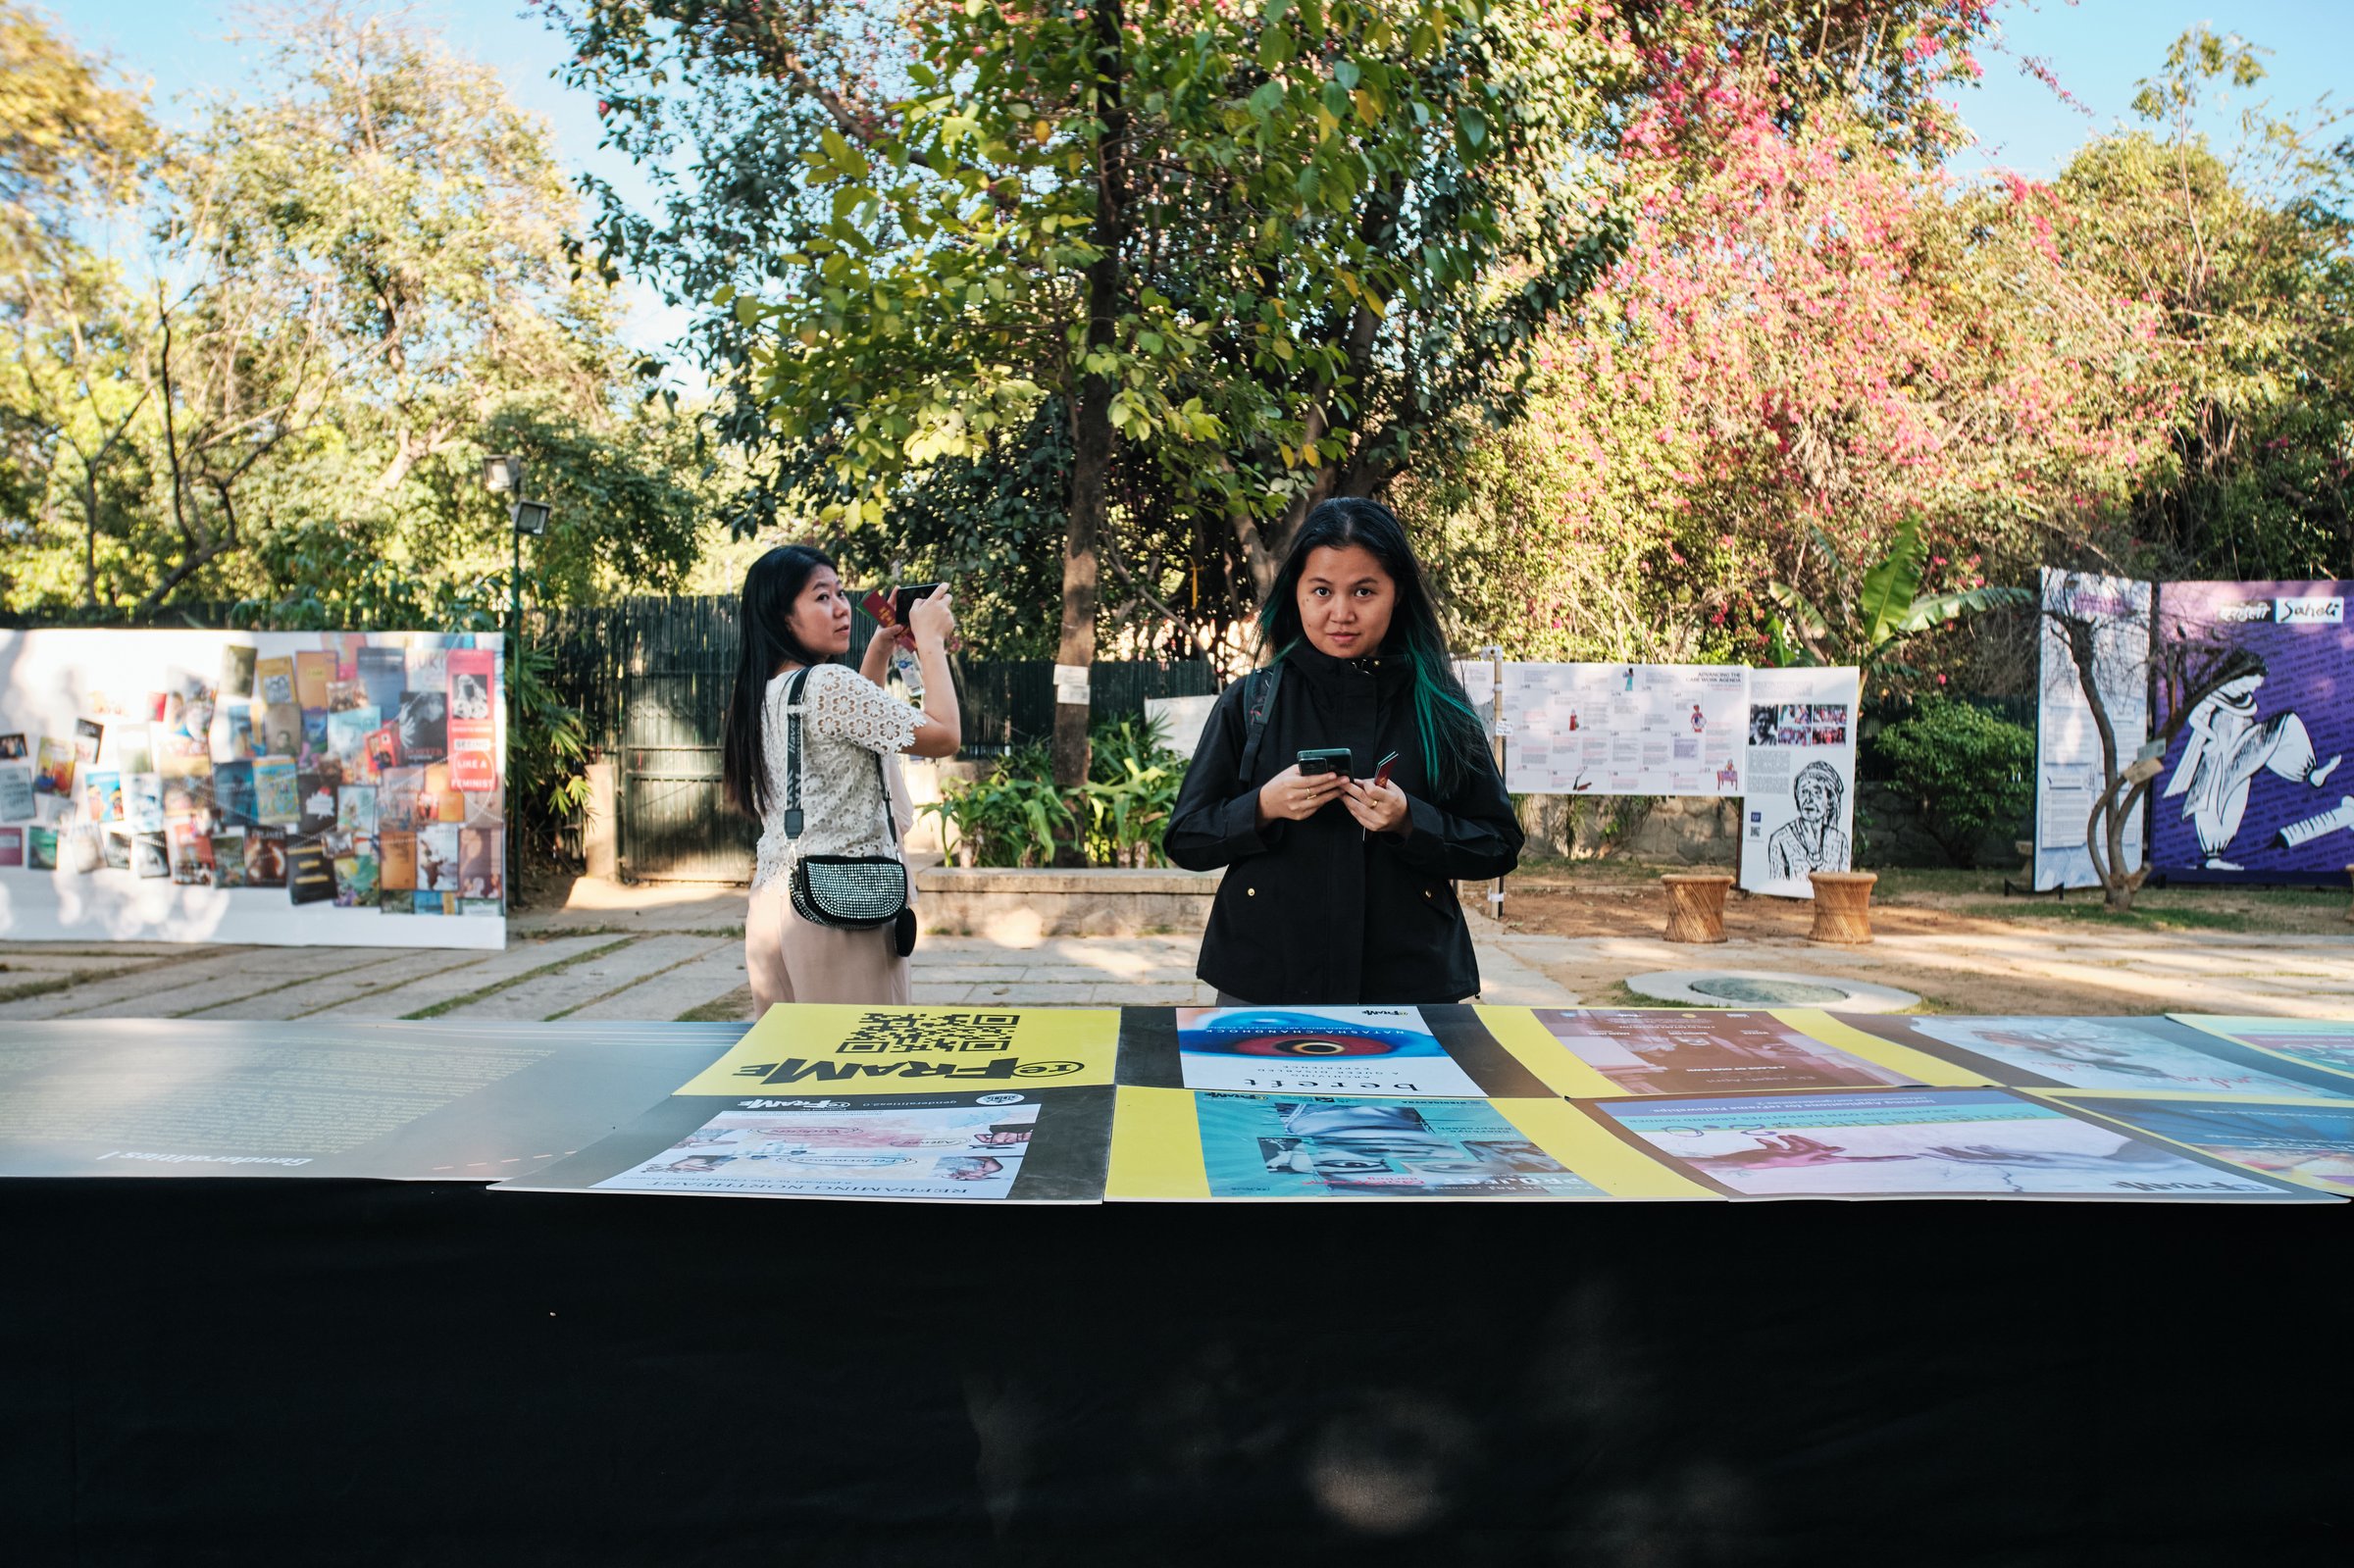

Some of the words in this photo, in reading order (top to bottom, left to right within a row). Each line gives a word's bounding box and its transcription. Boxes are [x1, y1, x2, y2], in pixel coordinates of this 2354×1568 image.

[2280, 598, 2339, 623] Saheli
[457, 760, 477, 770] LIKE
[480, 760, 487, 769] A
[451, 780, 493, 788] FEMINIST
[1244, 1079, 1419, 1091] bereft
[119, 1151, 313, 1167] Genderalities
